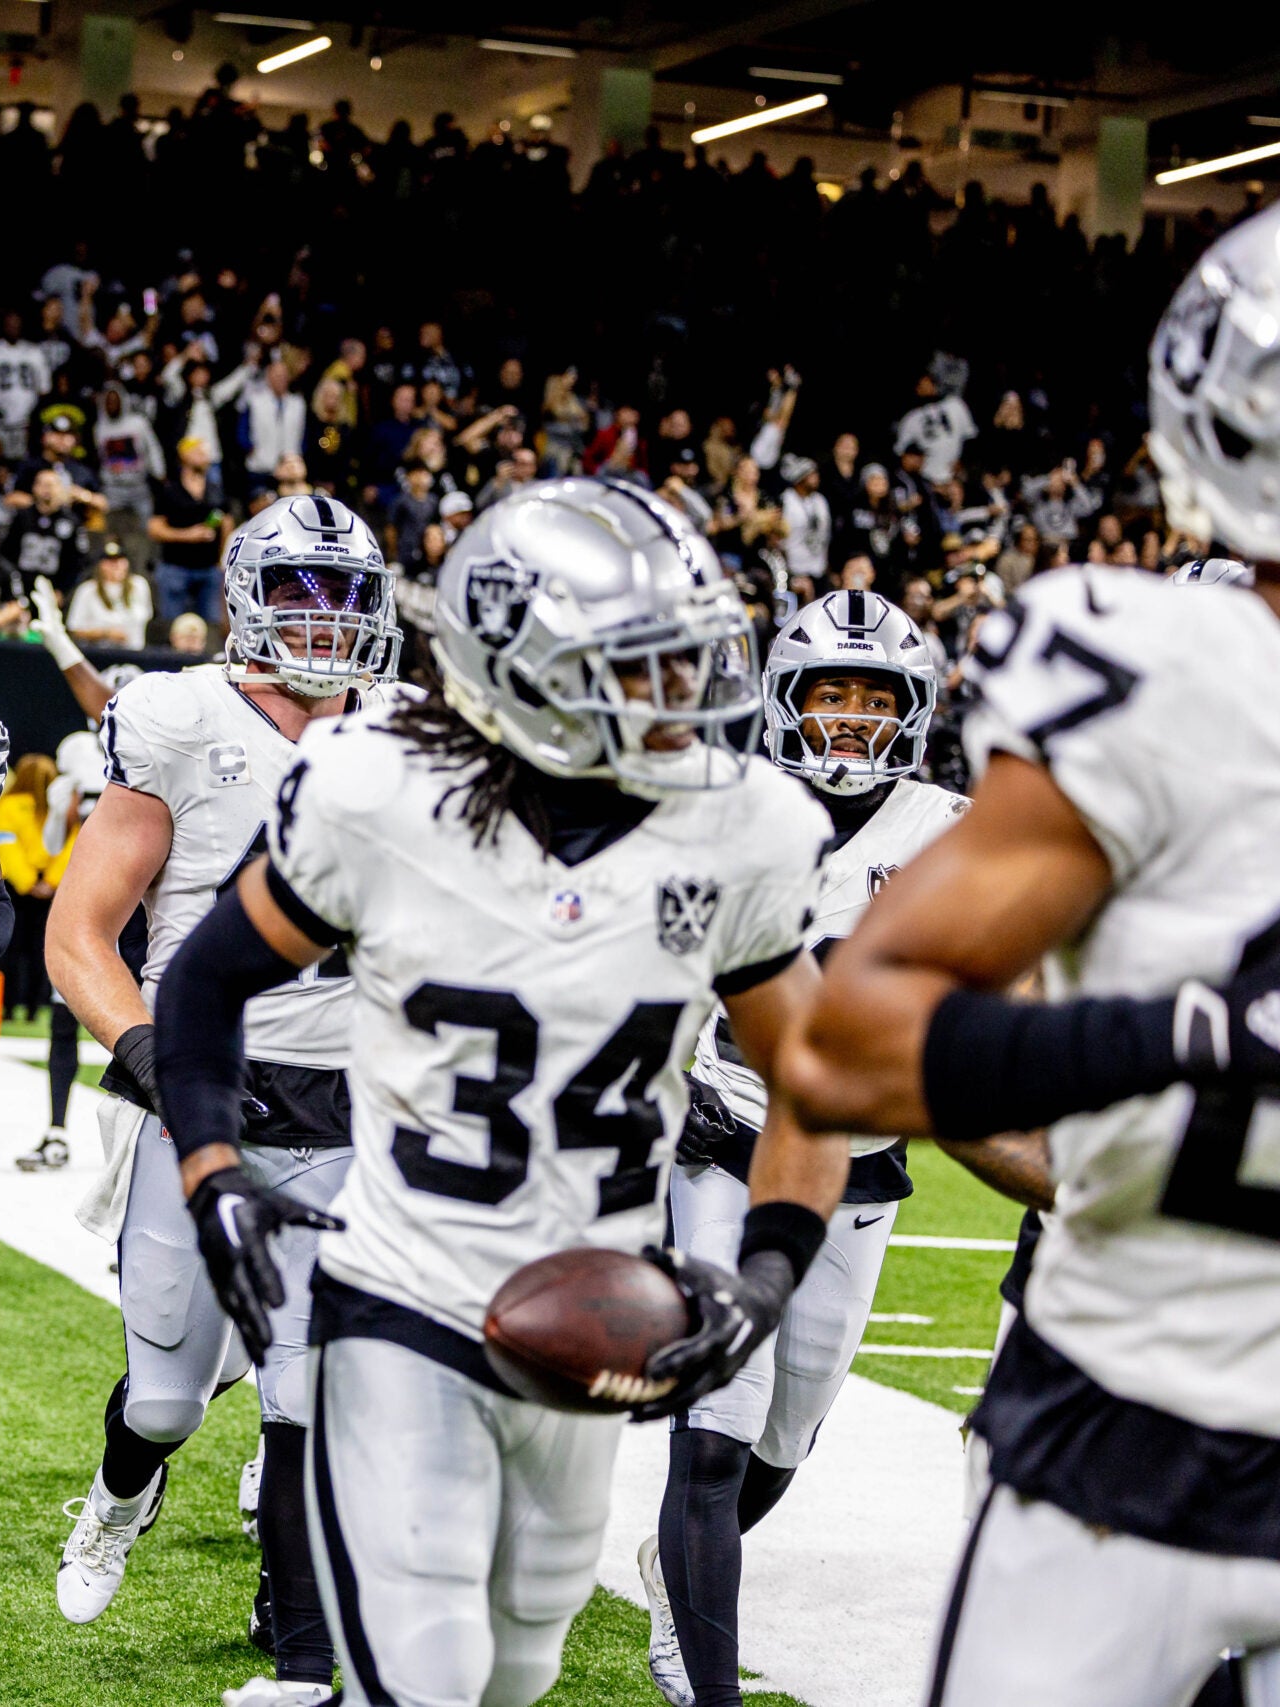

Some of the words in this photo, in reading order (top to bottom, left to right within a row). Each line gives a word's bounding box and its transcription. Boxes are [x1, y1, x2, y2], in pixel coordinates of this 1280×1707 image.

[314, 545, 350, 555] RAIDERS
[837, 643, 874, 651] RAIDERS
[208, 746, 247, 775] C
[390, 981, 692, 1218] 34
